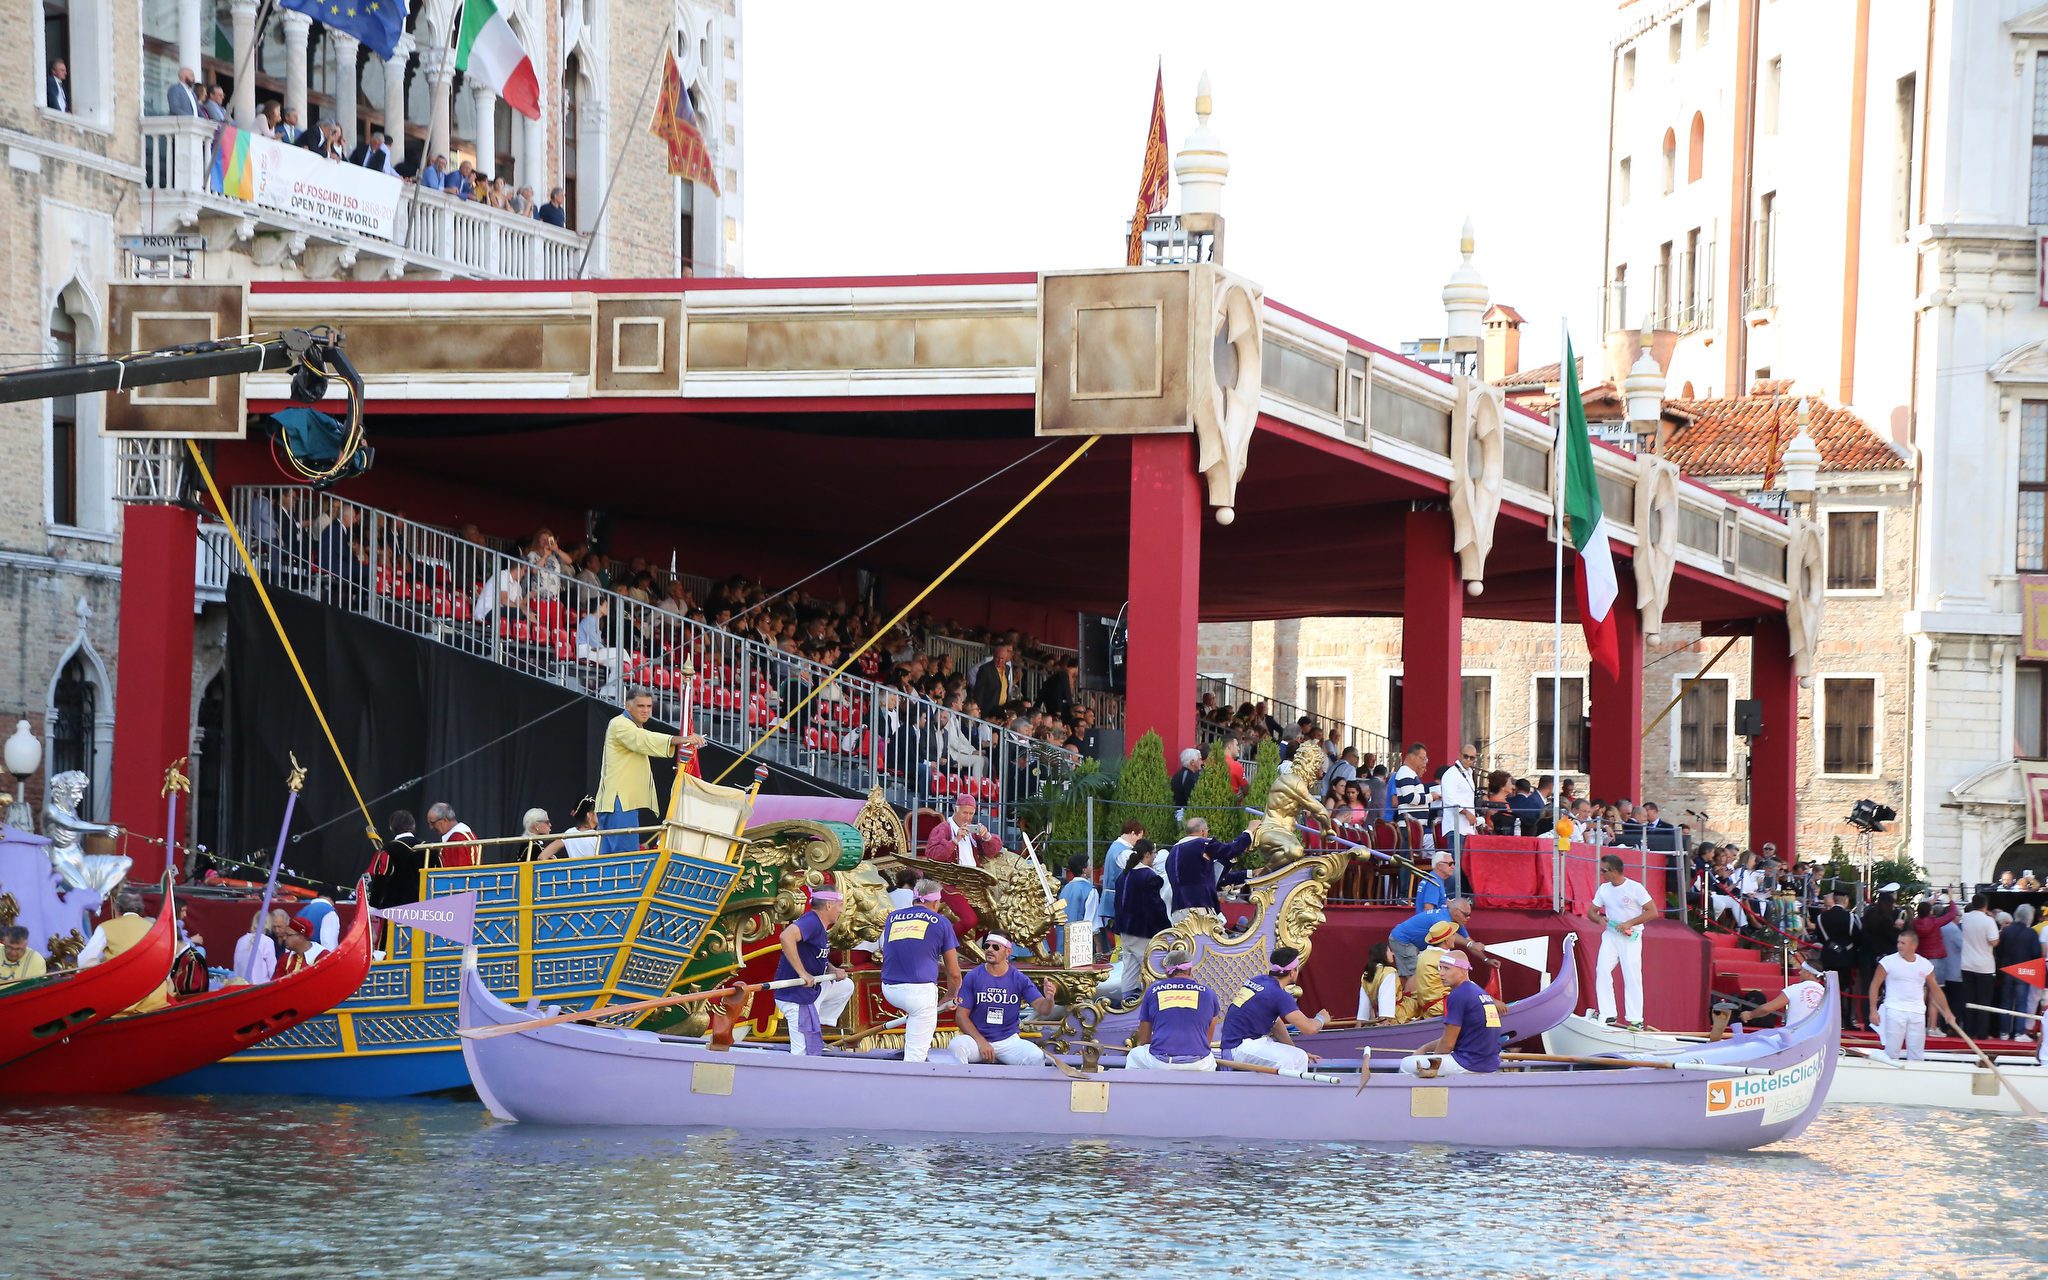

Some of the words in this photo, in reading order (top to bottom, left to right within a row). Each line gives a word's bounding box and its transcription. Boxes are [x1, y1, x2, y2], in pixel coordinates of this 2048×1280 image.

[306, 184, 342, 204] FOSCARI
[343, 195, 358, 209] 150
[291, 195, 314, 211] OPEN
[314, 201, 326, 215] TO
[327, 205, 343, 220] THE
[345, 210, 379, 230] WORLD
[143, 235, 189, 247] PROLYTE
[419, 910, 454, 922] JESOLO
[1512, 946, 1527, 956] LIDO
[1152, 983, 1184, 994] SANDRO
[1185, 983, 1206, 992] CIACI
[976, 991, 1019, 1005] JESOLO
[1735, 1059, 1820, 1097] HotelsClick
[1734, 1095, 1765, 1109] .com
